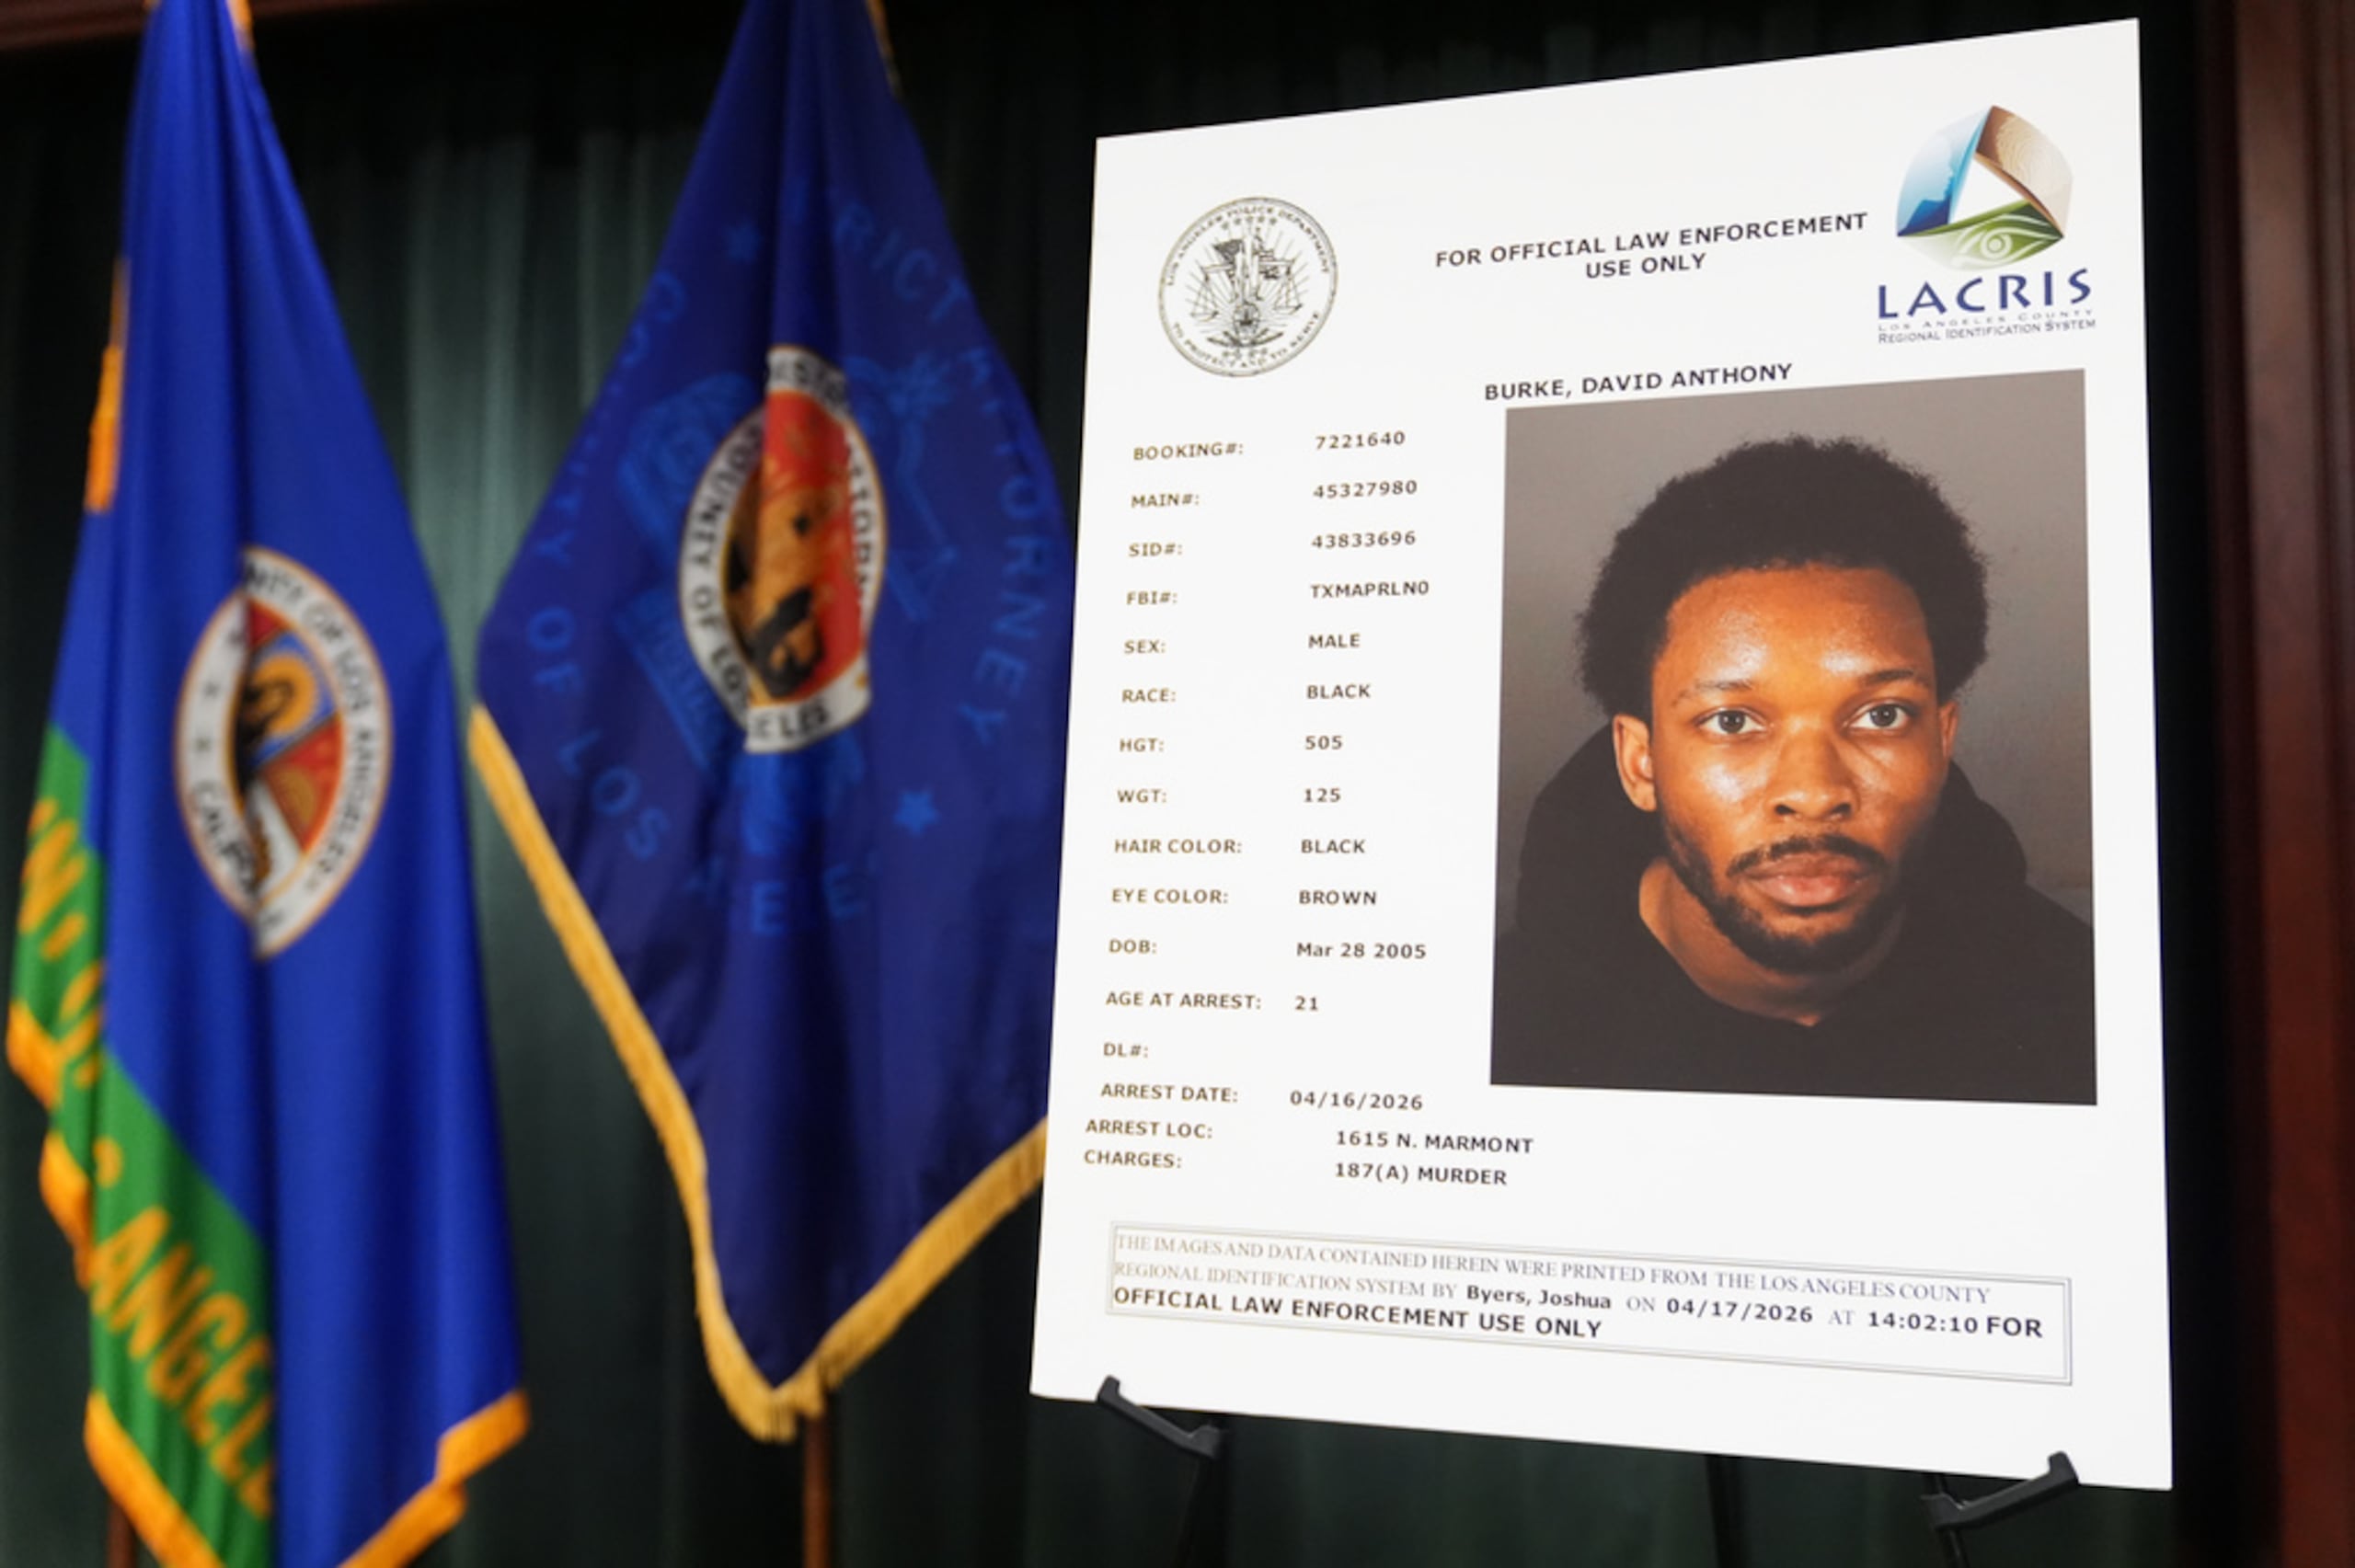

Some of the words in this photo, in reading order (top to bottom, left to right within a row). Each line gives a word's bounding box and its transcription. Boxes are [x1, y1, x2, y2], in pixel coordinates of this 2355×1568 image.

[1437, 248, 1481, 267] FOR
[1490, 238, 1605, 262] OFFICIAL
[1616, 232, 1669, 251] LAW
[1680, 212, 1867, 246] ENFORCEMENT
[1587, 259, 1630, 279] USE
[1641, 253, 1706, 273] ONLY
[1878, 268, 2091, 318] LACRIS
[1486, 380, 1571, 400] BURKE,
[1582, 373, 1662, 394] DAVID
[1671, 363, 1792, 387] ANTHONY
[1133, 442, 1242, 460] BOOKING#:
[1316, 431, 1405, 449] 7221640
[1132, 494, 1198, 508] MAIN#:
[1314, 480, 1417, 498] 45327980
[1130, 543, 1181, 556] SID#:
[1312, 531, 1416, 548] 43833696
[1127, 591, 1176, 605] FBI#:
[1125, 640, 1164, 653] SEX:
[1309, 634, 1359, 647] MALE
[1122, 689, 1175, 703] RACE:
[1307, 684, 1370, 699] BLACK
[1120, 738, 1163, 751] HGT:
[1306, 736, 1342, 750] 505
[1118, 789, 1166, 803] WGT:
[1305, 788, 1340, 802] 125
[1115, 840, 1161, 853] HAIR
[1168, 840, 1241, 853] COLOR:
[1302, 840, 1364, 853] BLACK
[1112, 889, 1146, 902] EYE
[1155, 889, 1227, 903] COLOR:
[1299, 890, 1376, 905] BROWN
[1109, 939, 1155, 954] DOB:
[1297, 943, 1332, 956] Mar
[1341, 943, 1364, 957] 28
[1374, 944, 1426, 958] 2005
[1106, 991, 1143, 1005] AGE
[1150, 993, 1173, 1006] AT
[1180, 993, 1260, 1009] ARREST:
[1295, 996, 1317, 1011] 21
[1104, 1043, 1148, 1057] DL#:
[1101, 1083, 1174, 1099] ARREST
[1182, 1087, 1236, 1102] DATE:
[1291, 1091, 1422, 1110] 04/16/2026
[1086, 1119, 1159, 1136] ARREST
[1166, 1123, 1212, 1139] LOC:
[1338, 1131, 1387, 1147] 1615
[1397, 1134, 1416, 1148] N.
[1425, 1135, 1533, 1153] MARMONT
[1085, 1150, 1180, 1168] CHARGES:
[1337, 1163, 1408, 1184] 187(A)
[1419, 1167, 1506, 1185] MURDER
[1118, 1234, 1151, 1251] THE
[1154, 1236, 1222, 1255] IMAGES
[1225, 1241, 1263, 1258] AND
[1269, 1243, 1315, 1262] DATA
[1319, 1245, 1426, 1268] CONTAINED
[1432, 1253, 1499, 1273] HEREIN
[1505, 1257, 1557, 1276] WERE
[1562, 1263, 1645, 1283] PRINTED
[1650, 1269, 1707, 1287] FROM
[1715, 1273, 1755, 1288] THE
[1761, 1274, 1799, 1291] LOS
[1801, 1277, 1895, 1299] ANGELES
[1900, 1283, 1991, 1305] COUNTY
[1114, 1263, 1202, 1282] REGIONAL
[1207, 1267, 1350, 1291] IDENTIFICATION
[1356, 1276, 1425, 1297] SYSTEM
[1431, 1282, 1457, 1299] BY
[1466, 1285, 1532, 1307] Byers,
[1538, 1289, 1611, 1310] Joshua
[1626, 1297, 1656, 1311] ON
[1667, 1299, 1813, 1324] 04/17/2026
[1828, 1310, 1855, 1326] AT
[1867, 1311, 1978, 1334] 14:02:10
[1986, 1317, 2043, 1339] FOR
[1114, 1287, 1222, 1310] OFFICIAL
[1231, 1295, 1281, 1315] LAW
[1292, 1299, 1468, 1329] ENFORCEMENT
[1479, 1314, 1524, 1332] USE
[1535, 1317, 1601, 1339] ONLY
